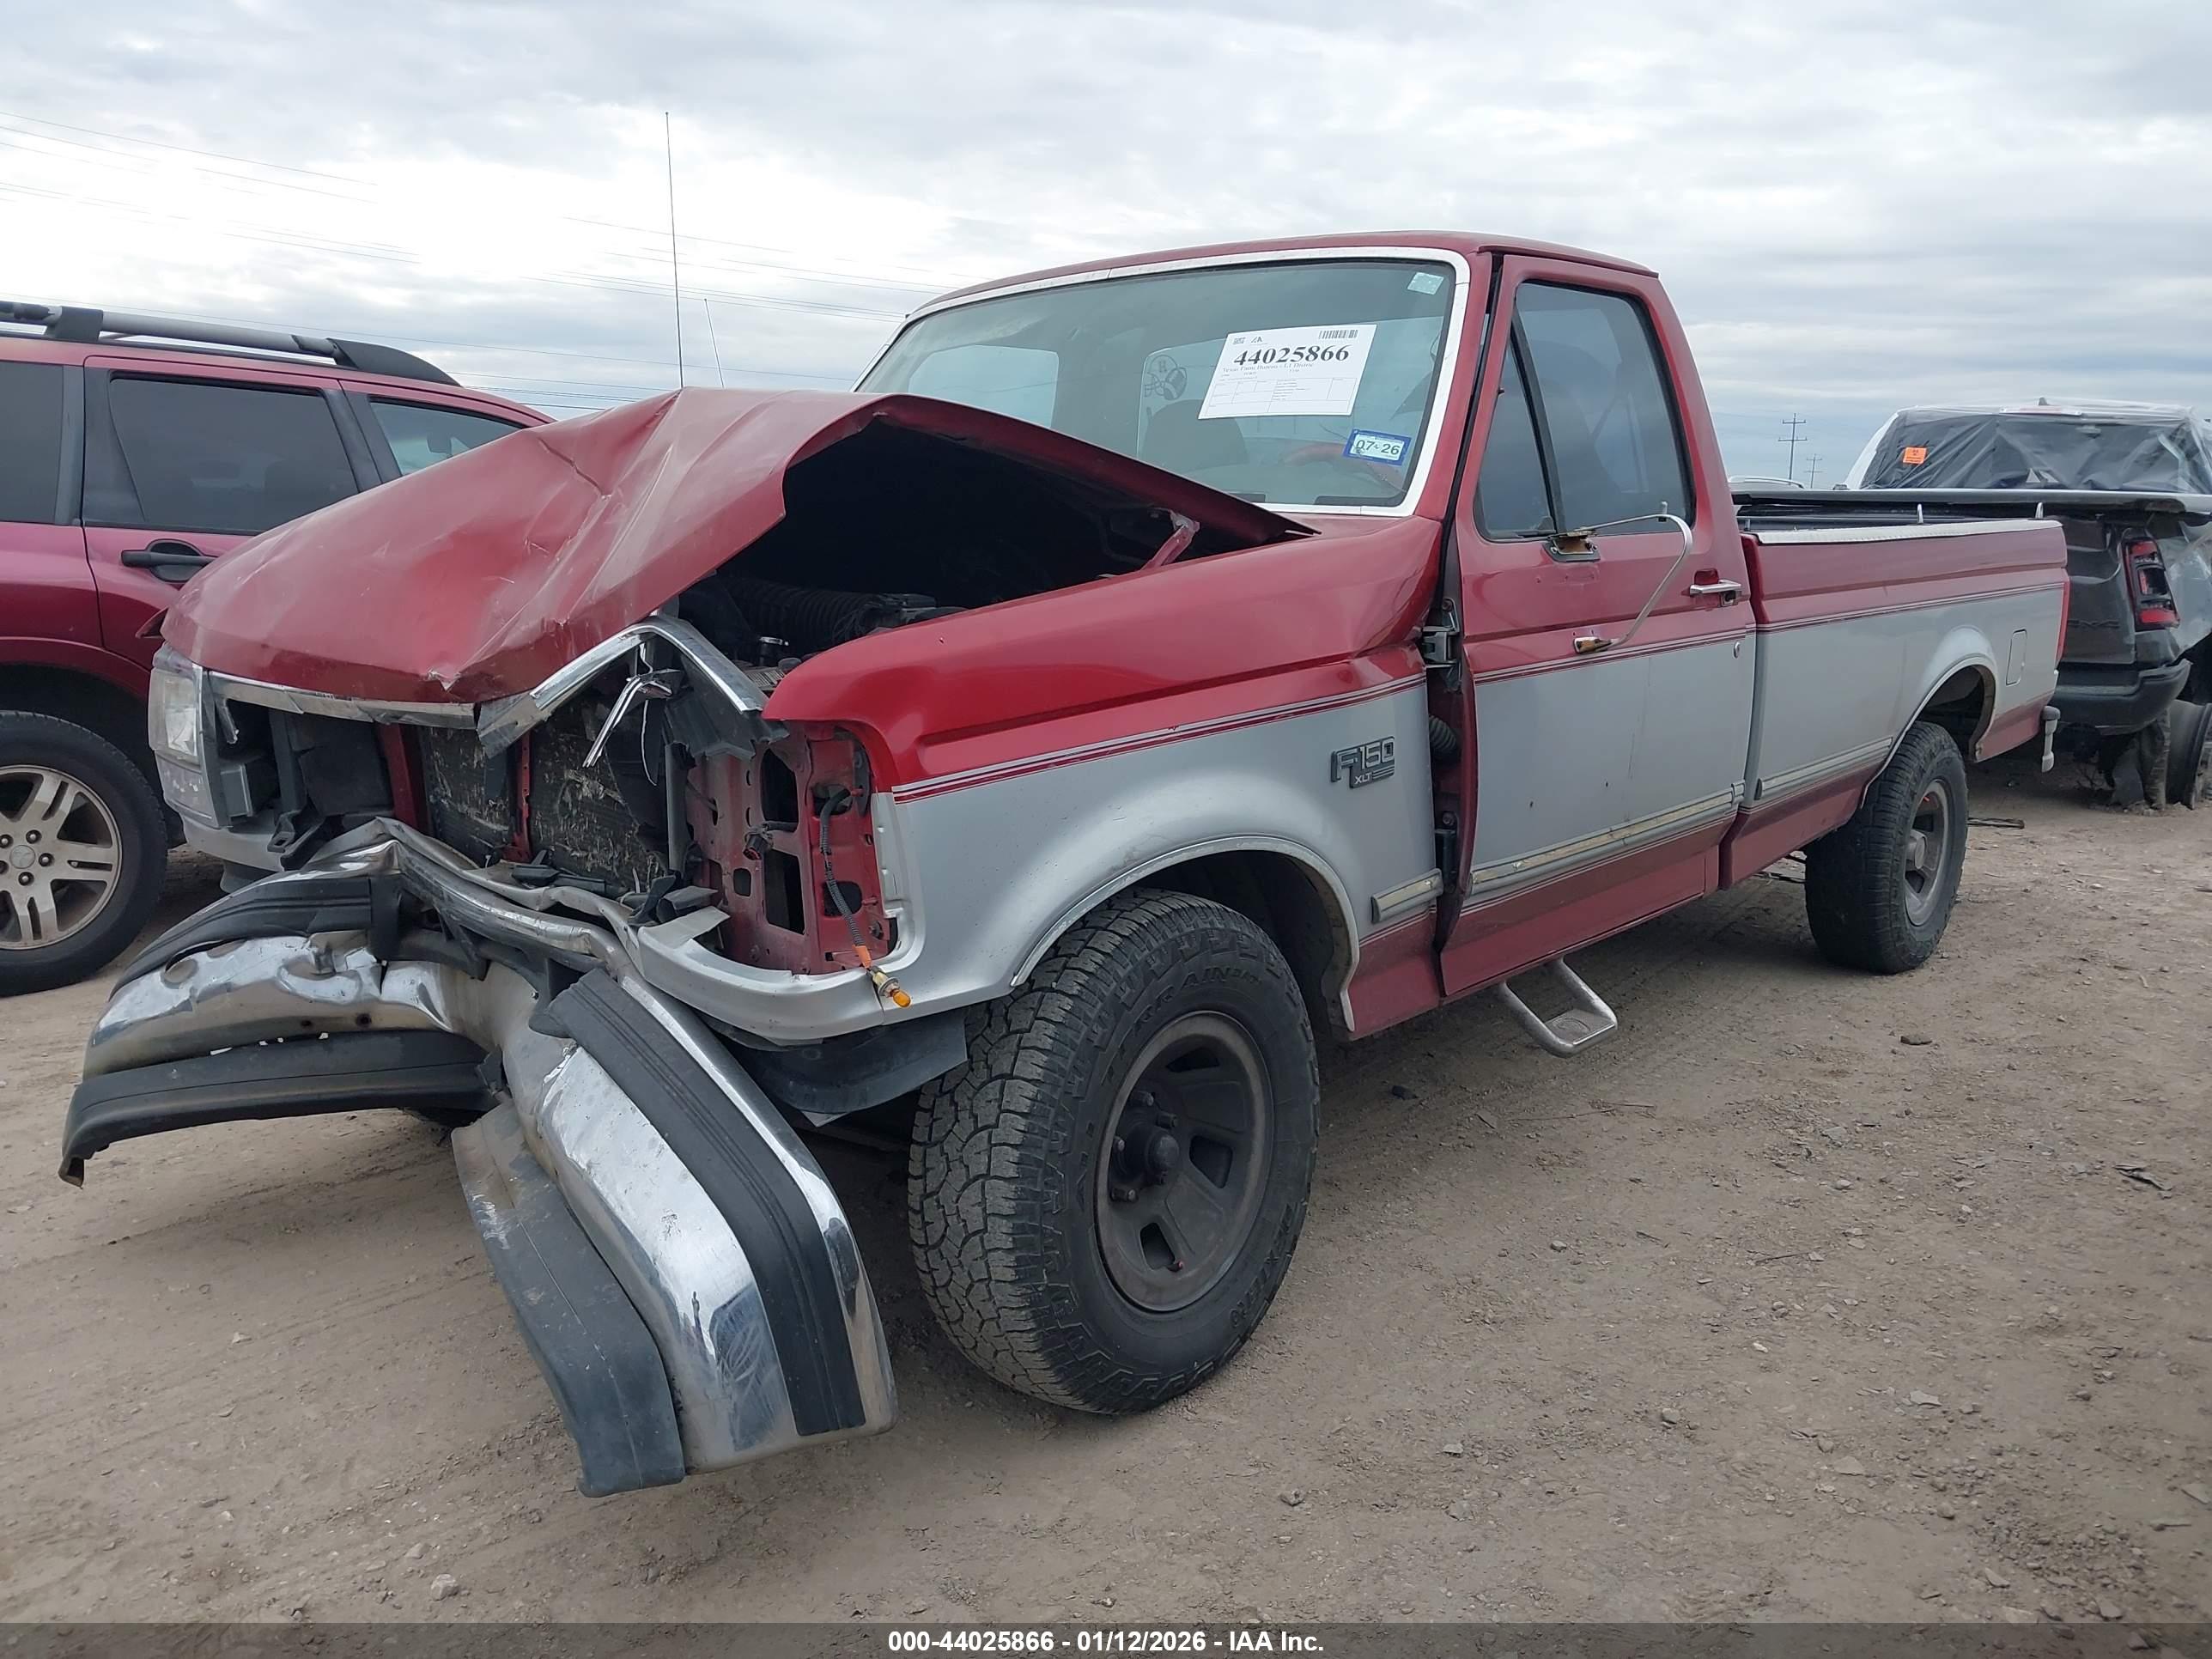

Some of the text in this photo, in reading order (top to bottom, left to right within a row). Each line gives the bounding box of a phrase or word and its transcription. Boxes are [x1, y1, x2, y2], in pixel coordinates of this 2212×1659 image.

[1233, 344, 1352, 366] 44025866
[1356, 439, 1401, 455] 07 26
[1354, 772, 1373, 785] XLT
